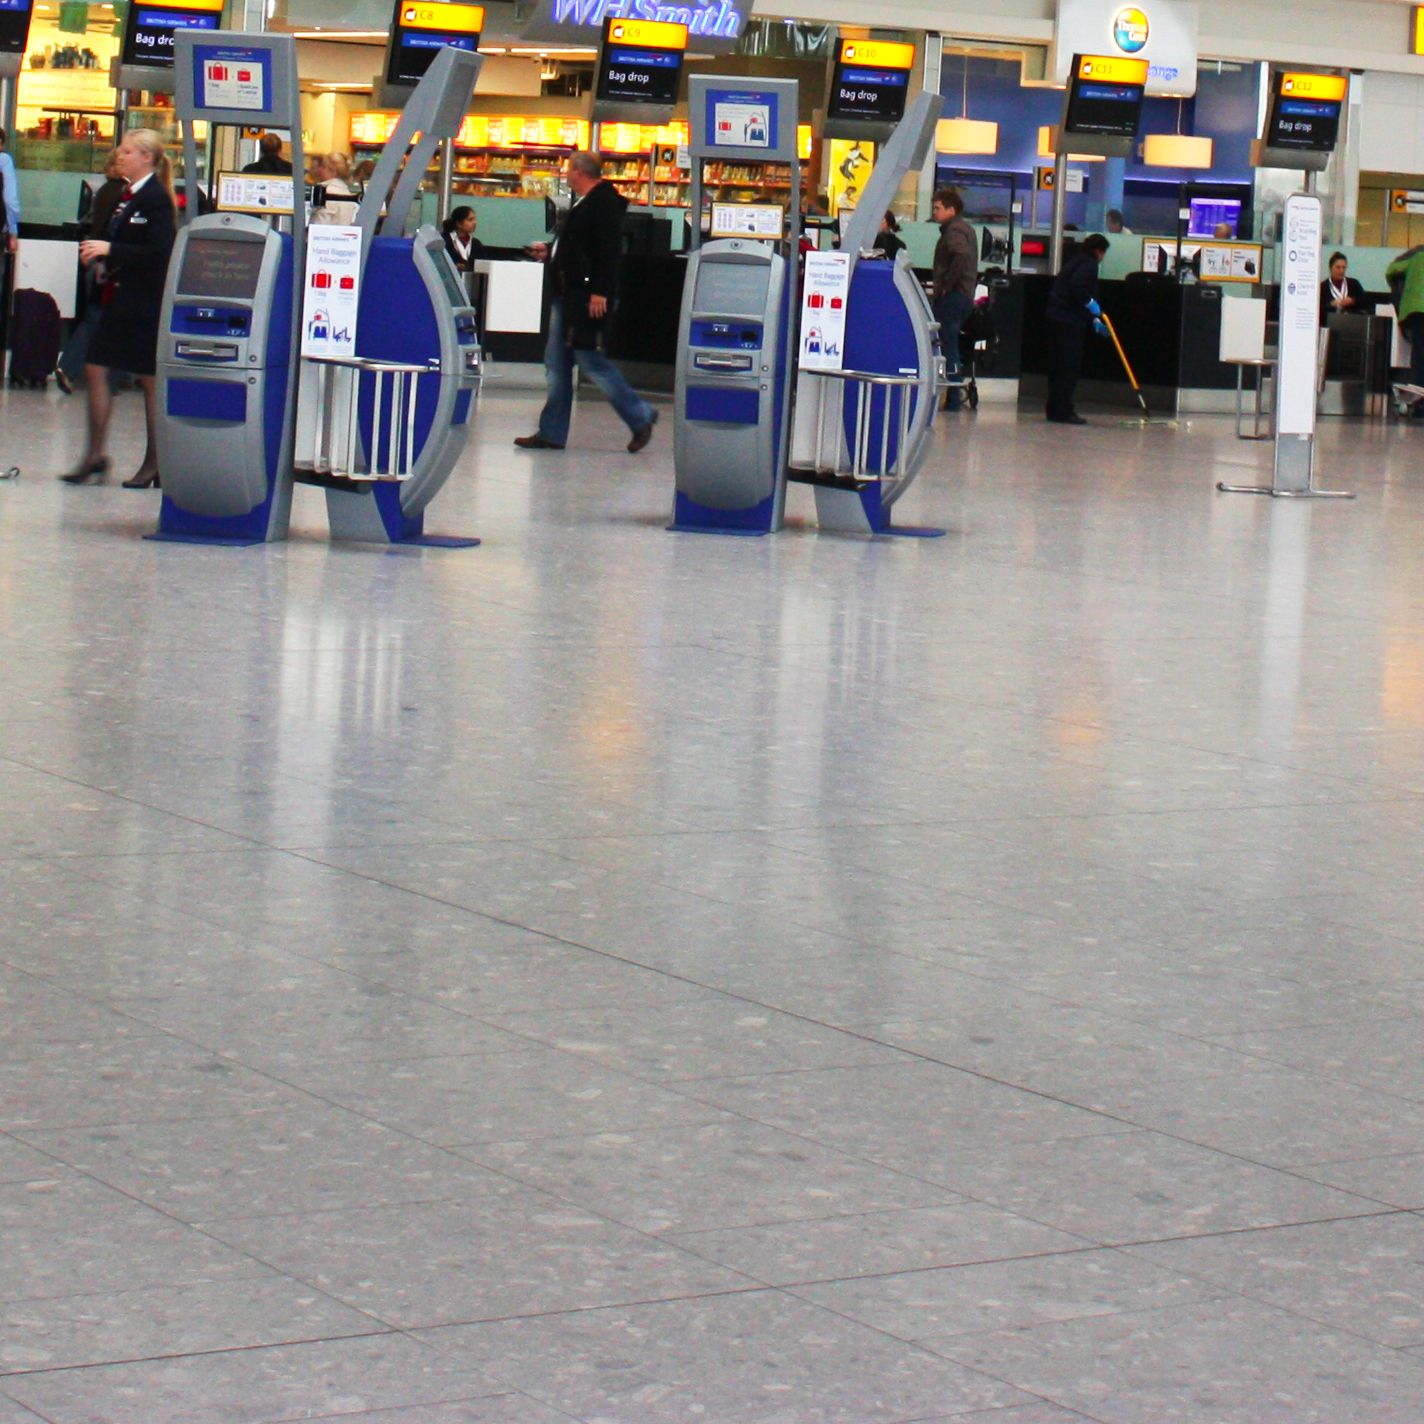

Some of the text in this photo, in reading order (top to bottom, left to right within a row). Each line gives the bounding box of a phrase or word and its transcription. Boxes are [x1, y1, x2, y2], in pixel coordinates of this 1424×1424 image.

[420, 9, 433, 20] C8
[627, 27, 641, 38] C9
[135, 33, 154, 47] Bag
[858, 47, 877, 58] C10
[609, 70, 649, 85] Bag drop
[840, 89, 878, 103] Bag drop
[1279, 119, 1312, 134] Bag drop
